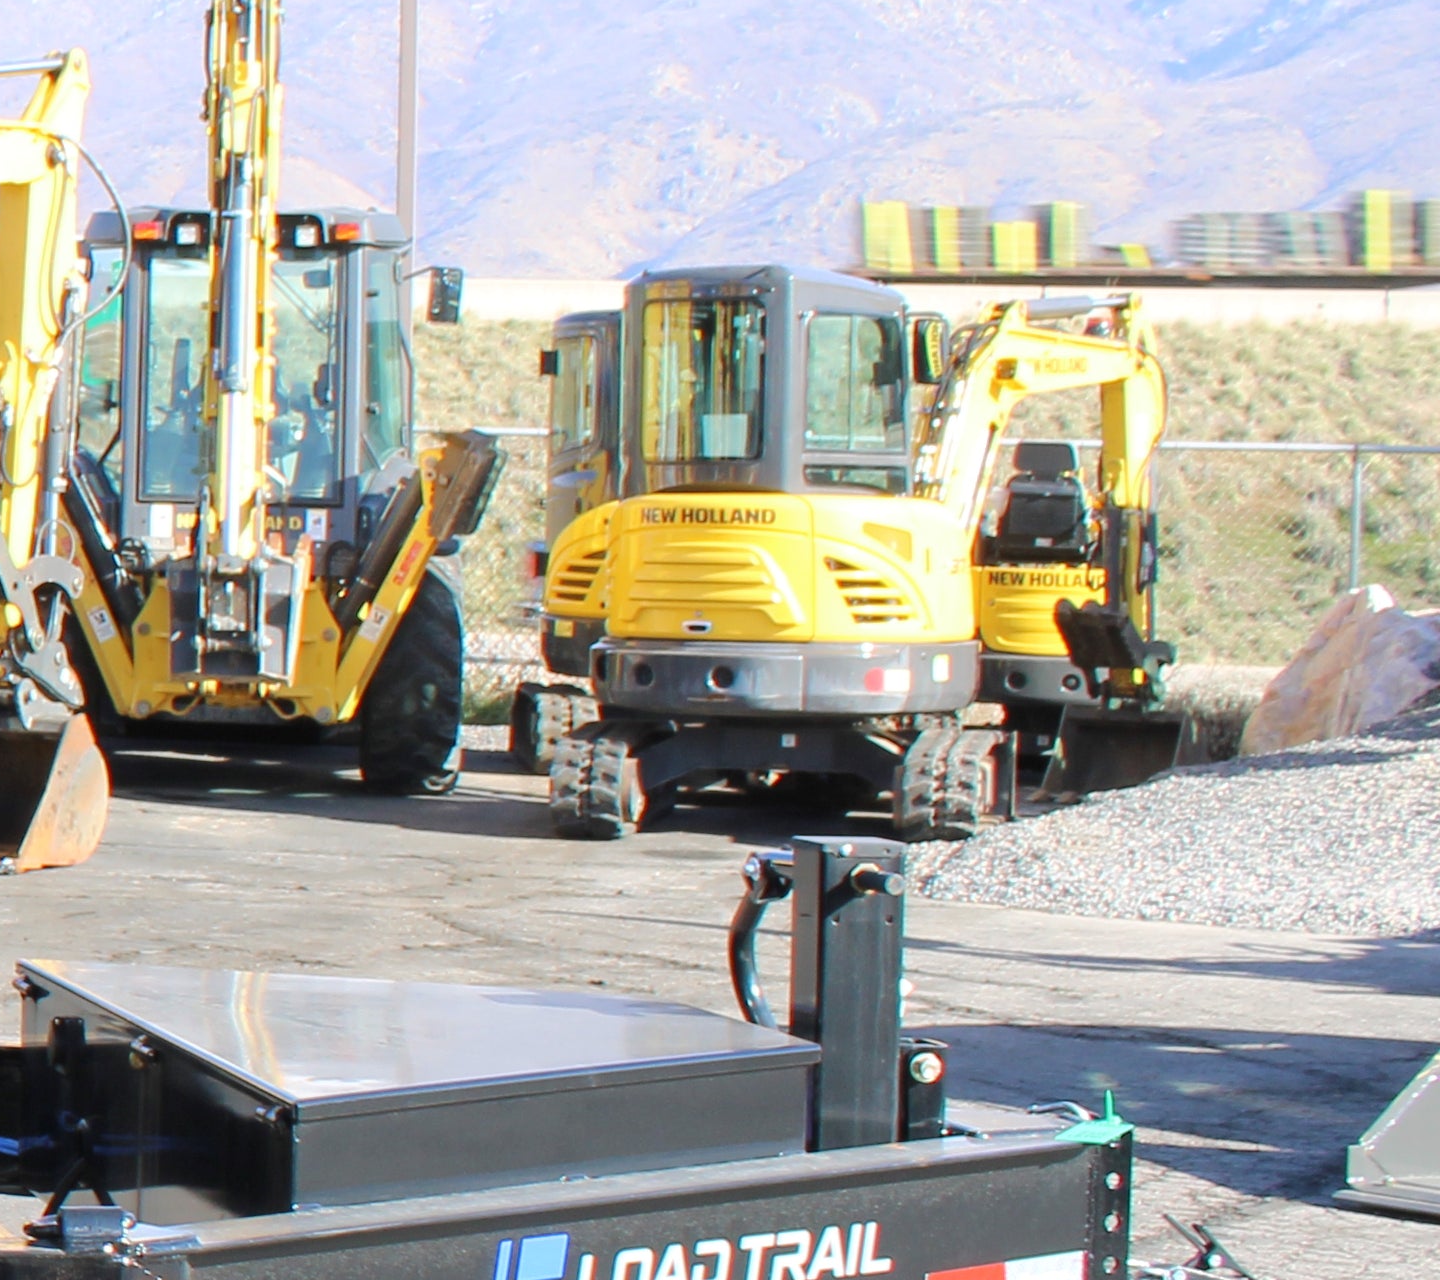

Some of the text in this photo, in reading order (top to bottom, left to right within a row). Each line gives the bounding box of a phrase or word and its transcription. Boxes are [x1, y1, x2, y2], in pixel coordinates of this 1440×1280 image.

[640, 507, 776, 525] NEW HOLLAND
[987, 571, 1026, 586] NEW
